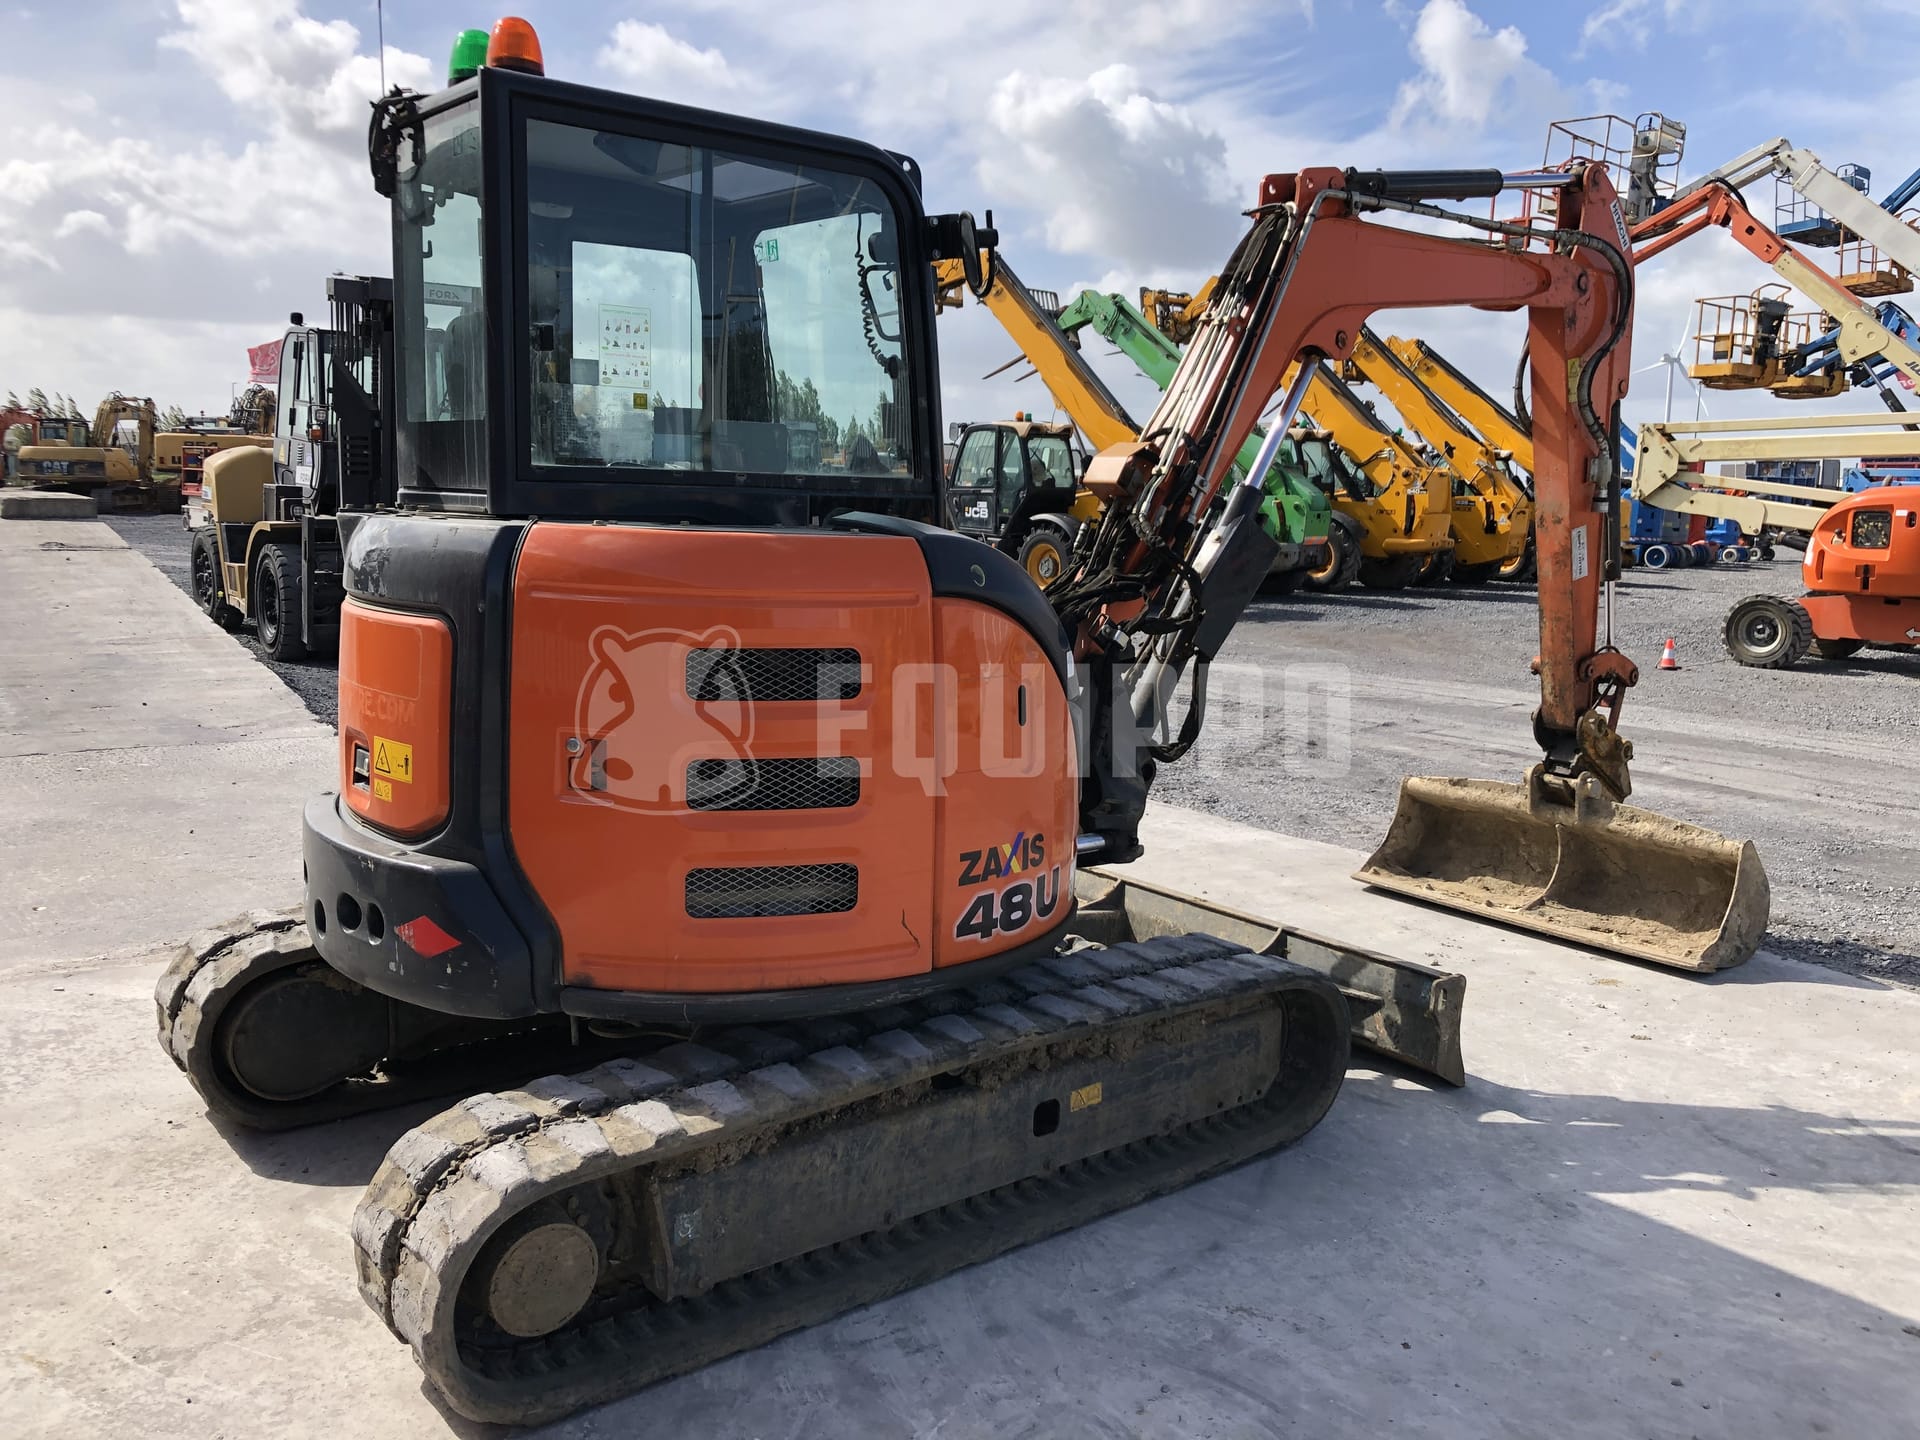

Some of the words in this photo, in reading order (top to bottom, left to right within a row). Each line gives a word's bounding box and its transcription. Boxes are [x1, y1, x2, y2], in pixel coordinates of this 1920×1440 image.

[1612, 201, 1628, 247] HITACHI
[42, 461, 69, 474] CAT
[964, 506, 989, 518] JCB
[958, 831, 1045, 887] ZAXIS
[956, 866, 1060, 940] 48U
